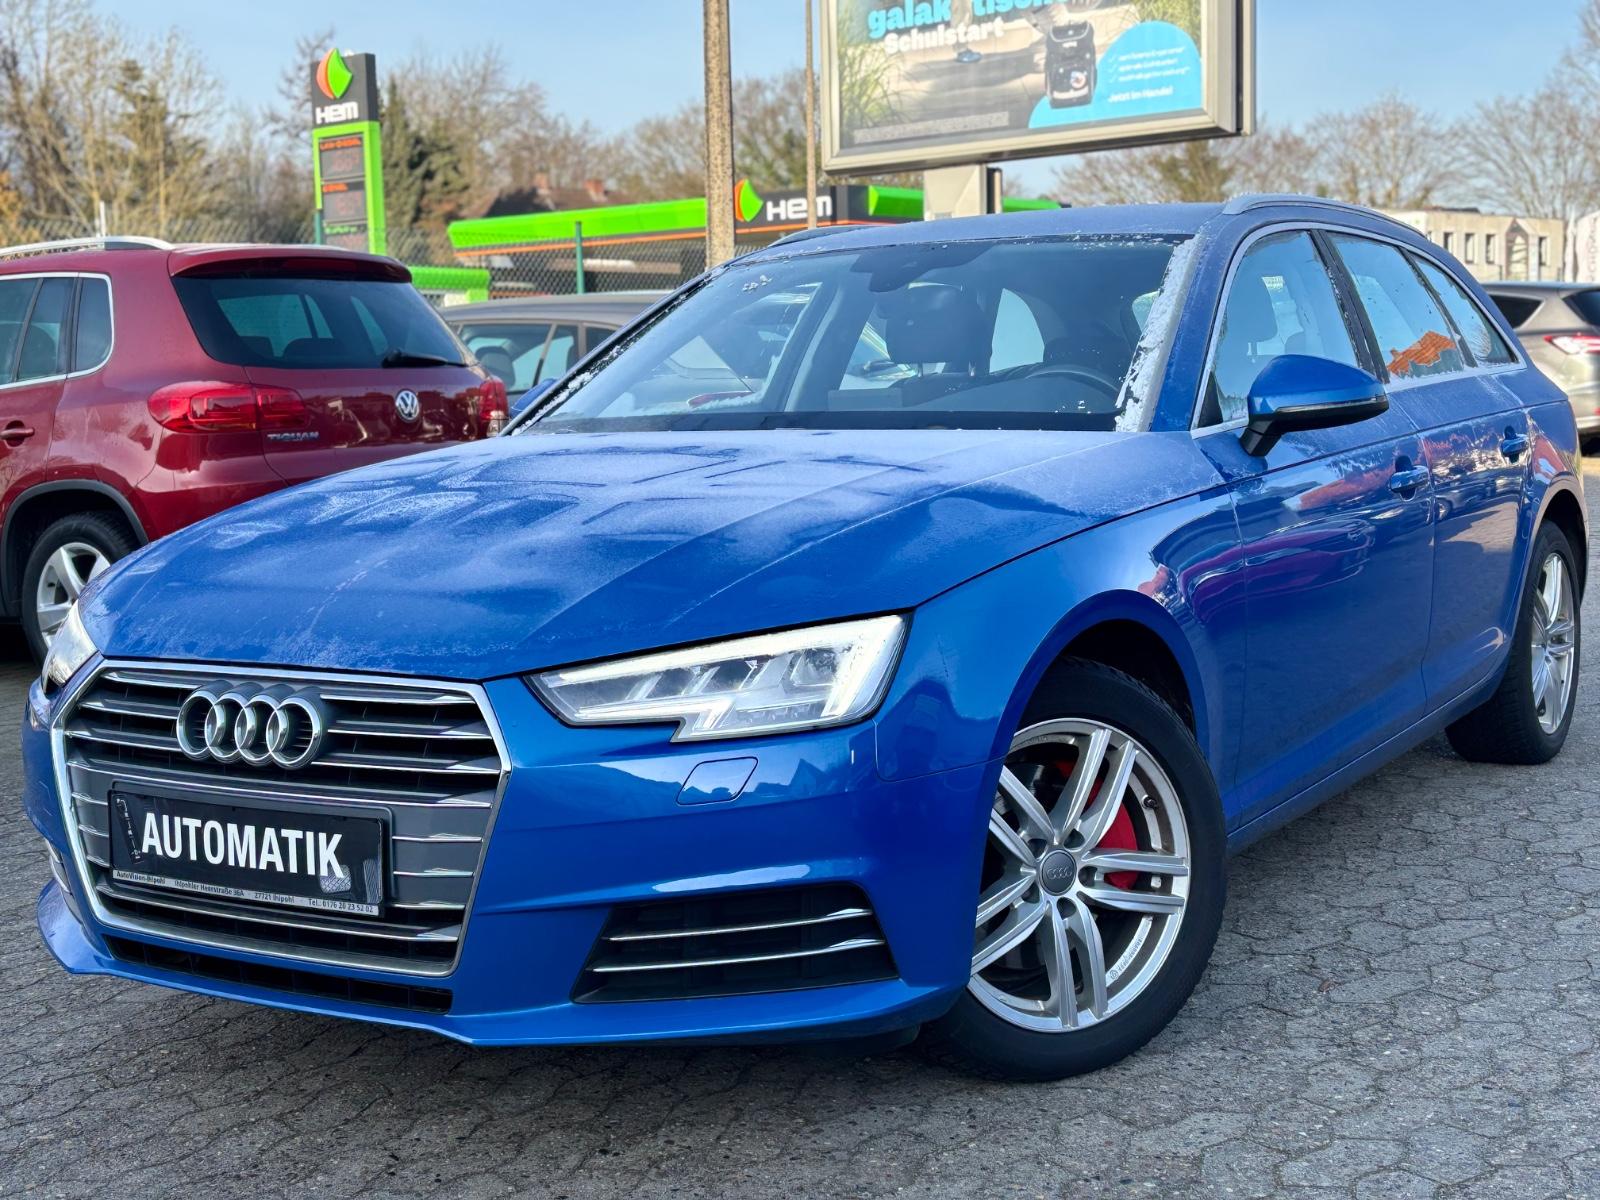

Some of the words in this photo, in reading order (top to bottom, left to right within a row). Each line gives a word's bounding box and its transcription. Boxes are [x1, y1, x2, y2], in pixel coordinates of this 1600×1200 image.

[885, 17, 1004, 54] Schulstart
[267, 431, 320, 442] TIGUAN
[141, 811, 345, 879] AUTOMATIK
[322, 900, 338, 909] 0176
[347, 902, 356, 911] 23
[356, 903, 364, 912] 52
[365, 904, 374, 913] 02
